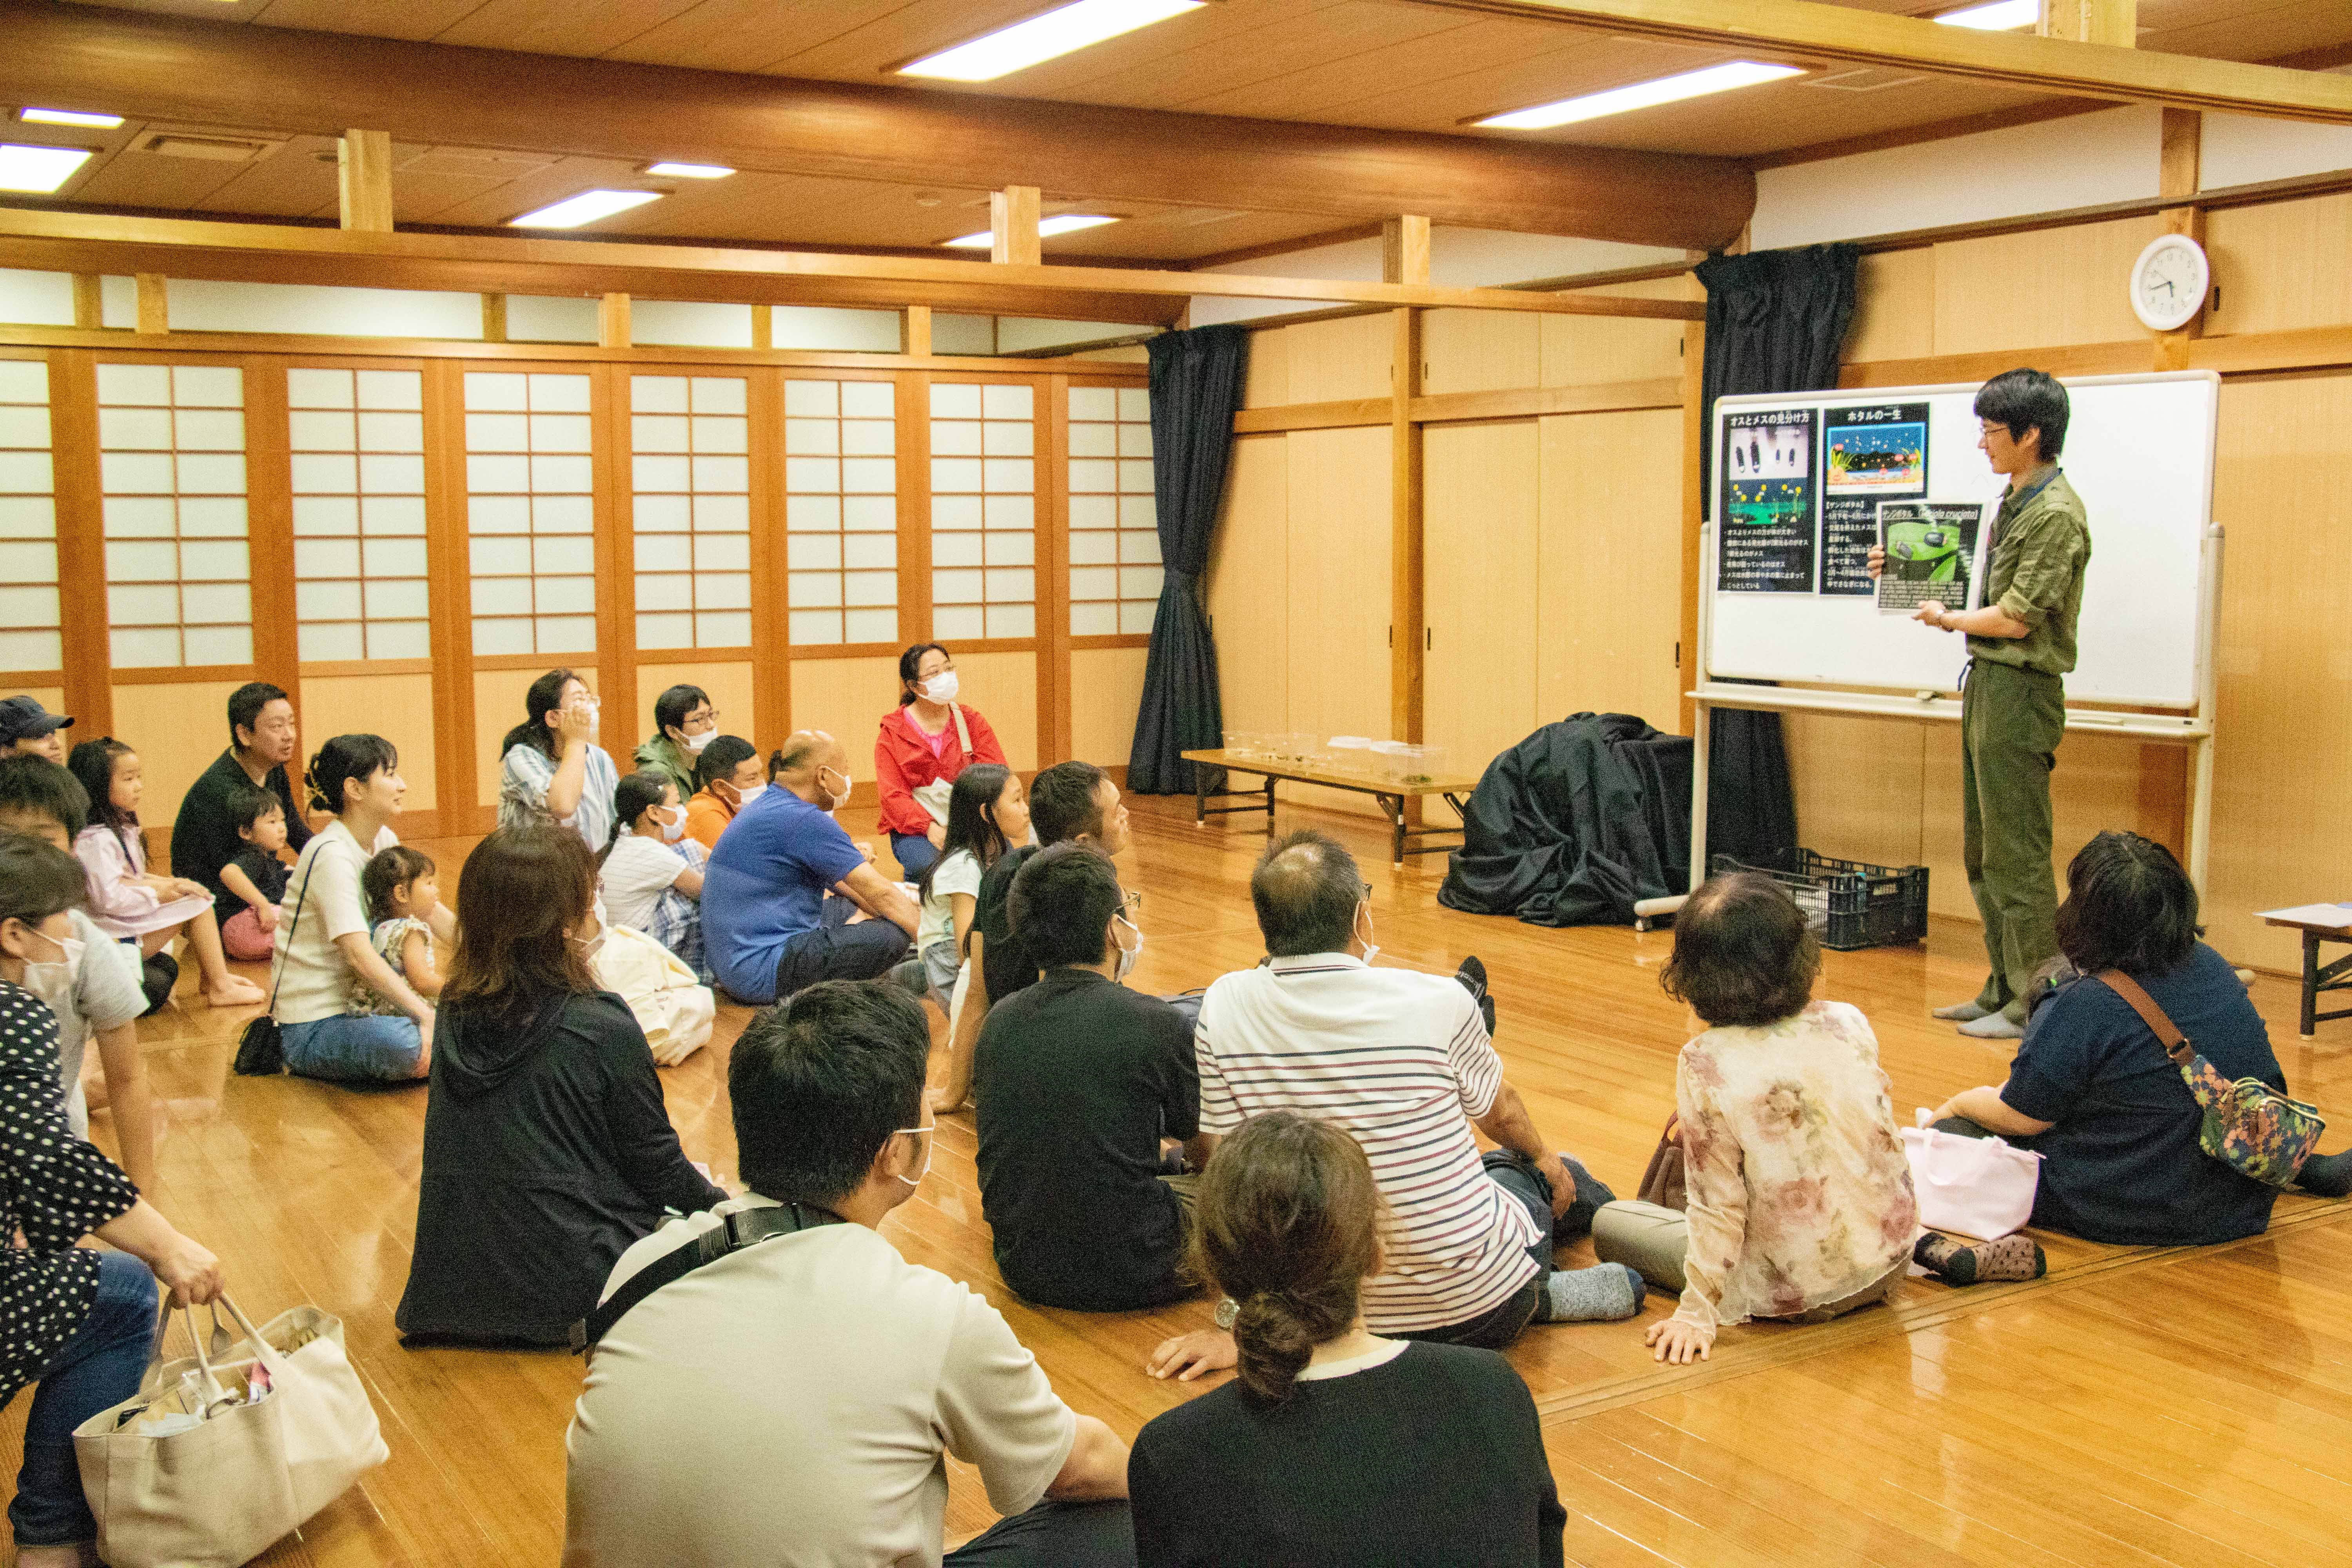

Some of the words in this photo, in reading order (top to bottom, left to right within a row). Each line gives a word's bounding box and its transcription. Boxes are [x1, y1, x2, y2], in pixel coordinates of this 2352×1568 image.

[1731, 413, 1809, 426] オスとメスの見分け方
[1848, 410, 1902, 421] ホタルの一生
